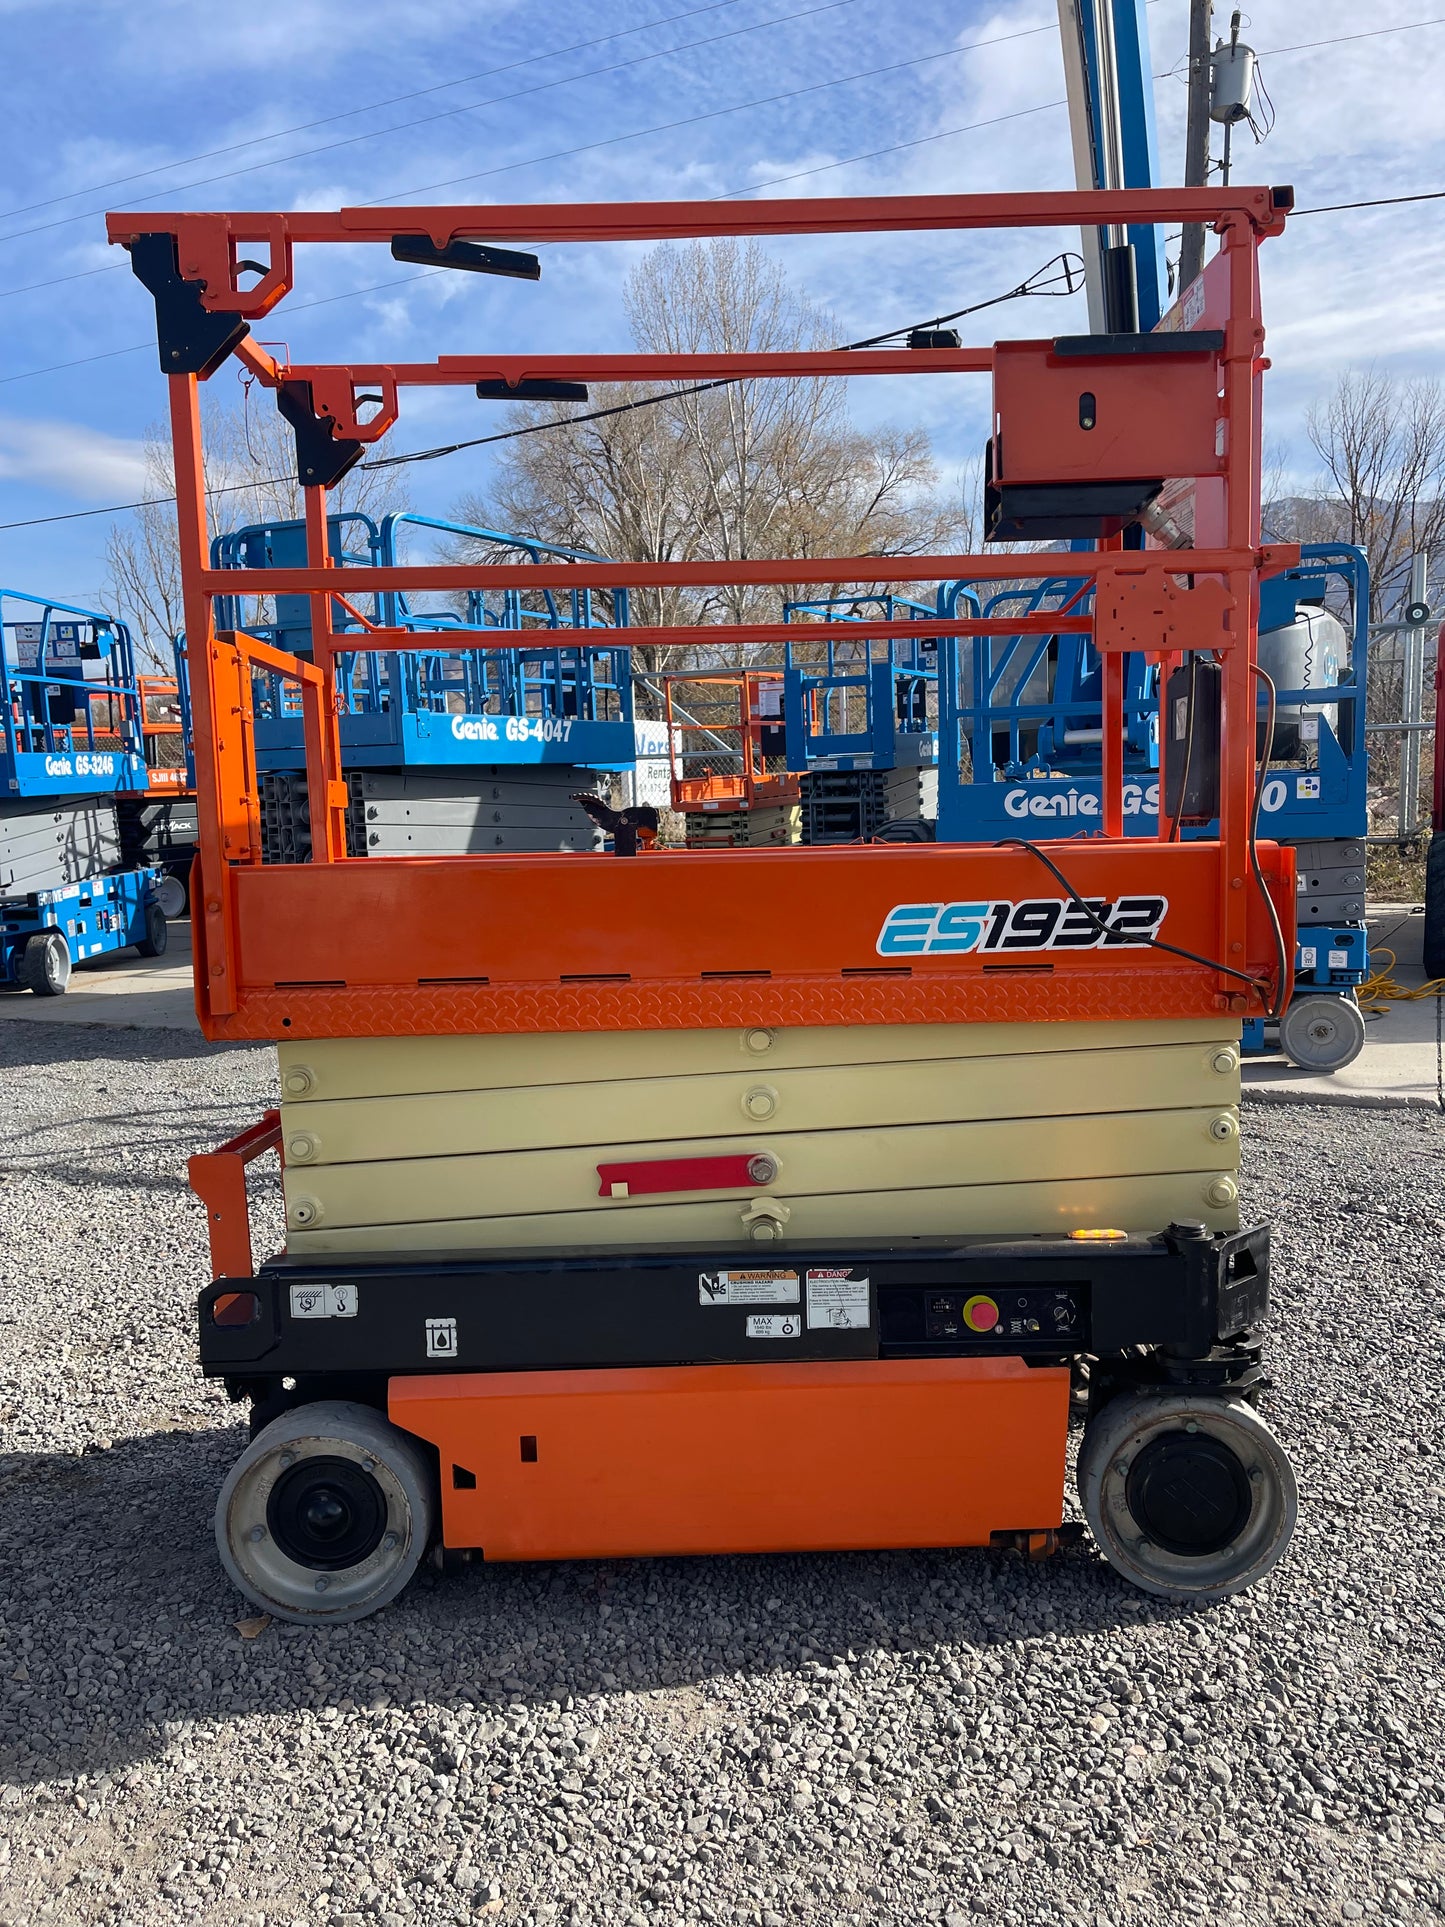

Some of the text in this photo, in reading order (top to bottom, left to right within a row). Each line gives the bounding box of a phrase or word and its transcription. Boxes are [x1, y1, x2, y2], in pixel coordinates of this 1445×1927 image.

[451, 716, 572, 742] Genie GS-4047
[45, 755, 114, 776] Genie GS-3246
[1004, 788, 1099, 818] Genie
[878, 898, 1166, 954] ES1932
[748, 1272, 787, 1280] WARNING
[753, 1317, 773, 1325] MAX
